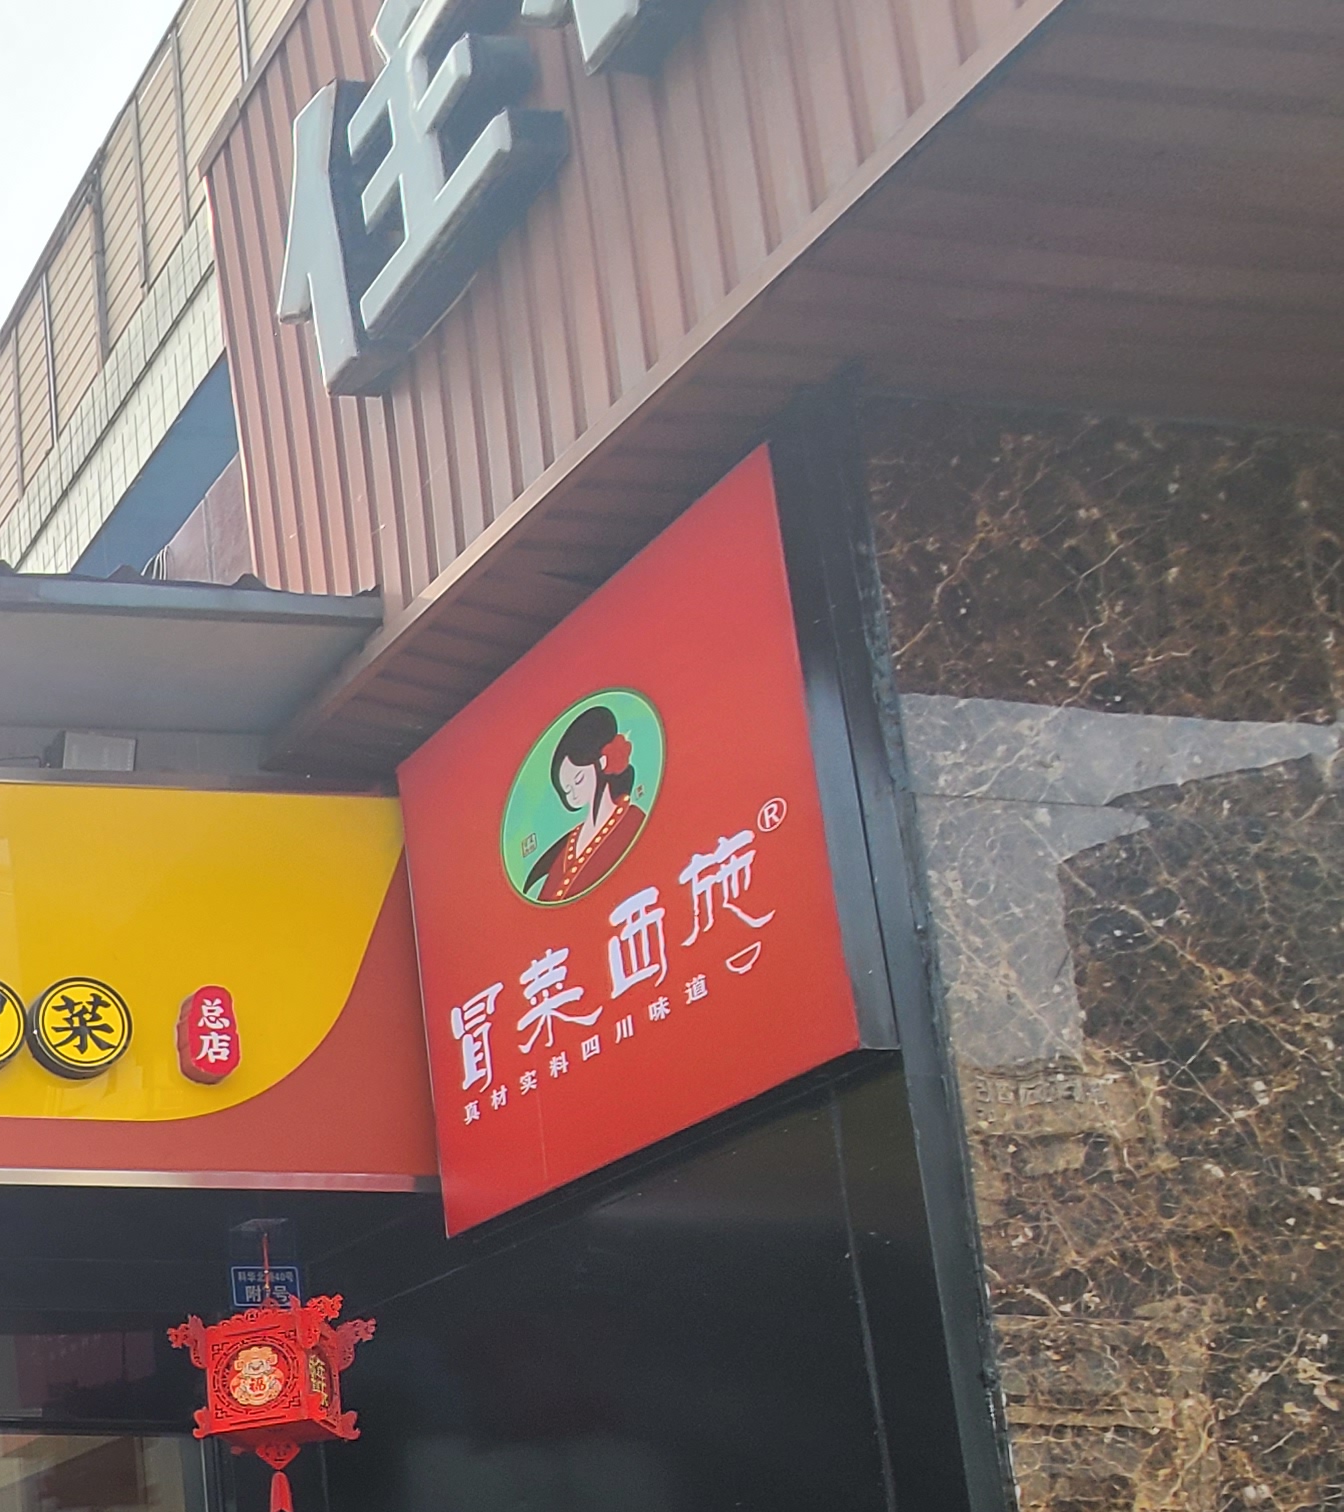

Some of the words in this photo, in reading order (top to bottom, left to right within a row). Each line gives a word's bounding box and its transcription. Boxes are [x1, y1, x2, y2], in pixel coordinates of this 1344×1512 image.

[451, 829, 776, 1093] 冒菜西施
[195, 997, 231, 1064] 总店
[463, 973, 709, 1126] 真材实料四川味道
[245, 1285, 289, 1302] 附号
